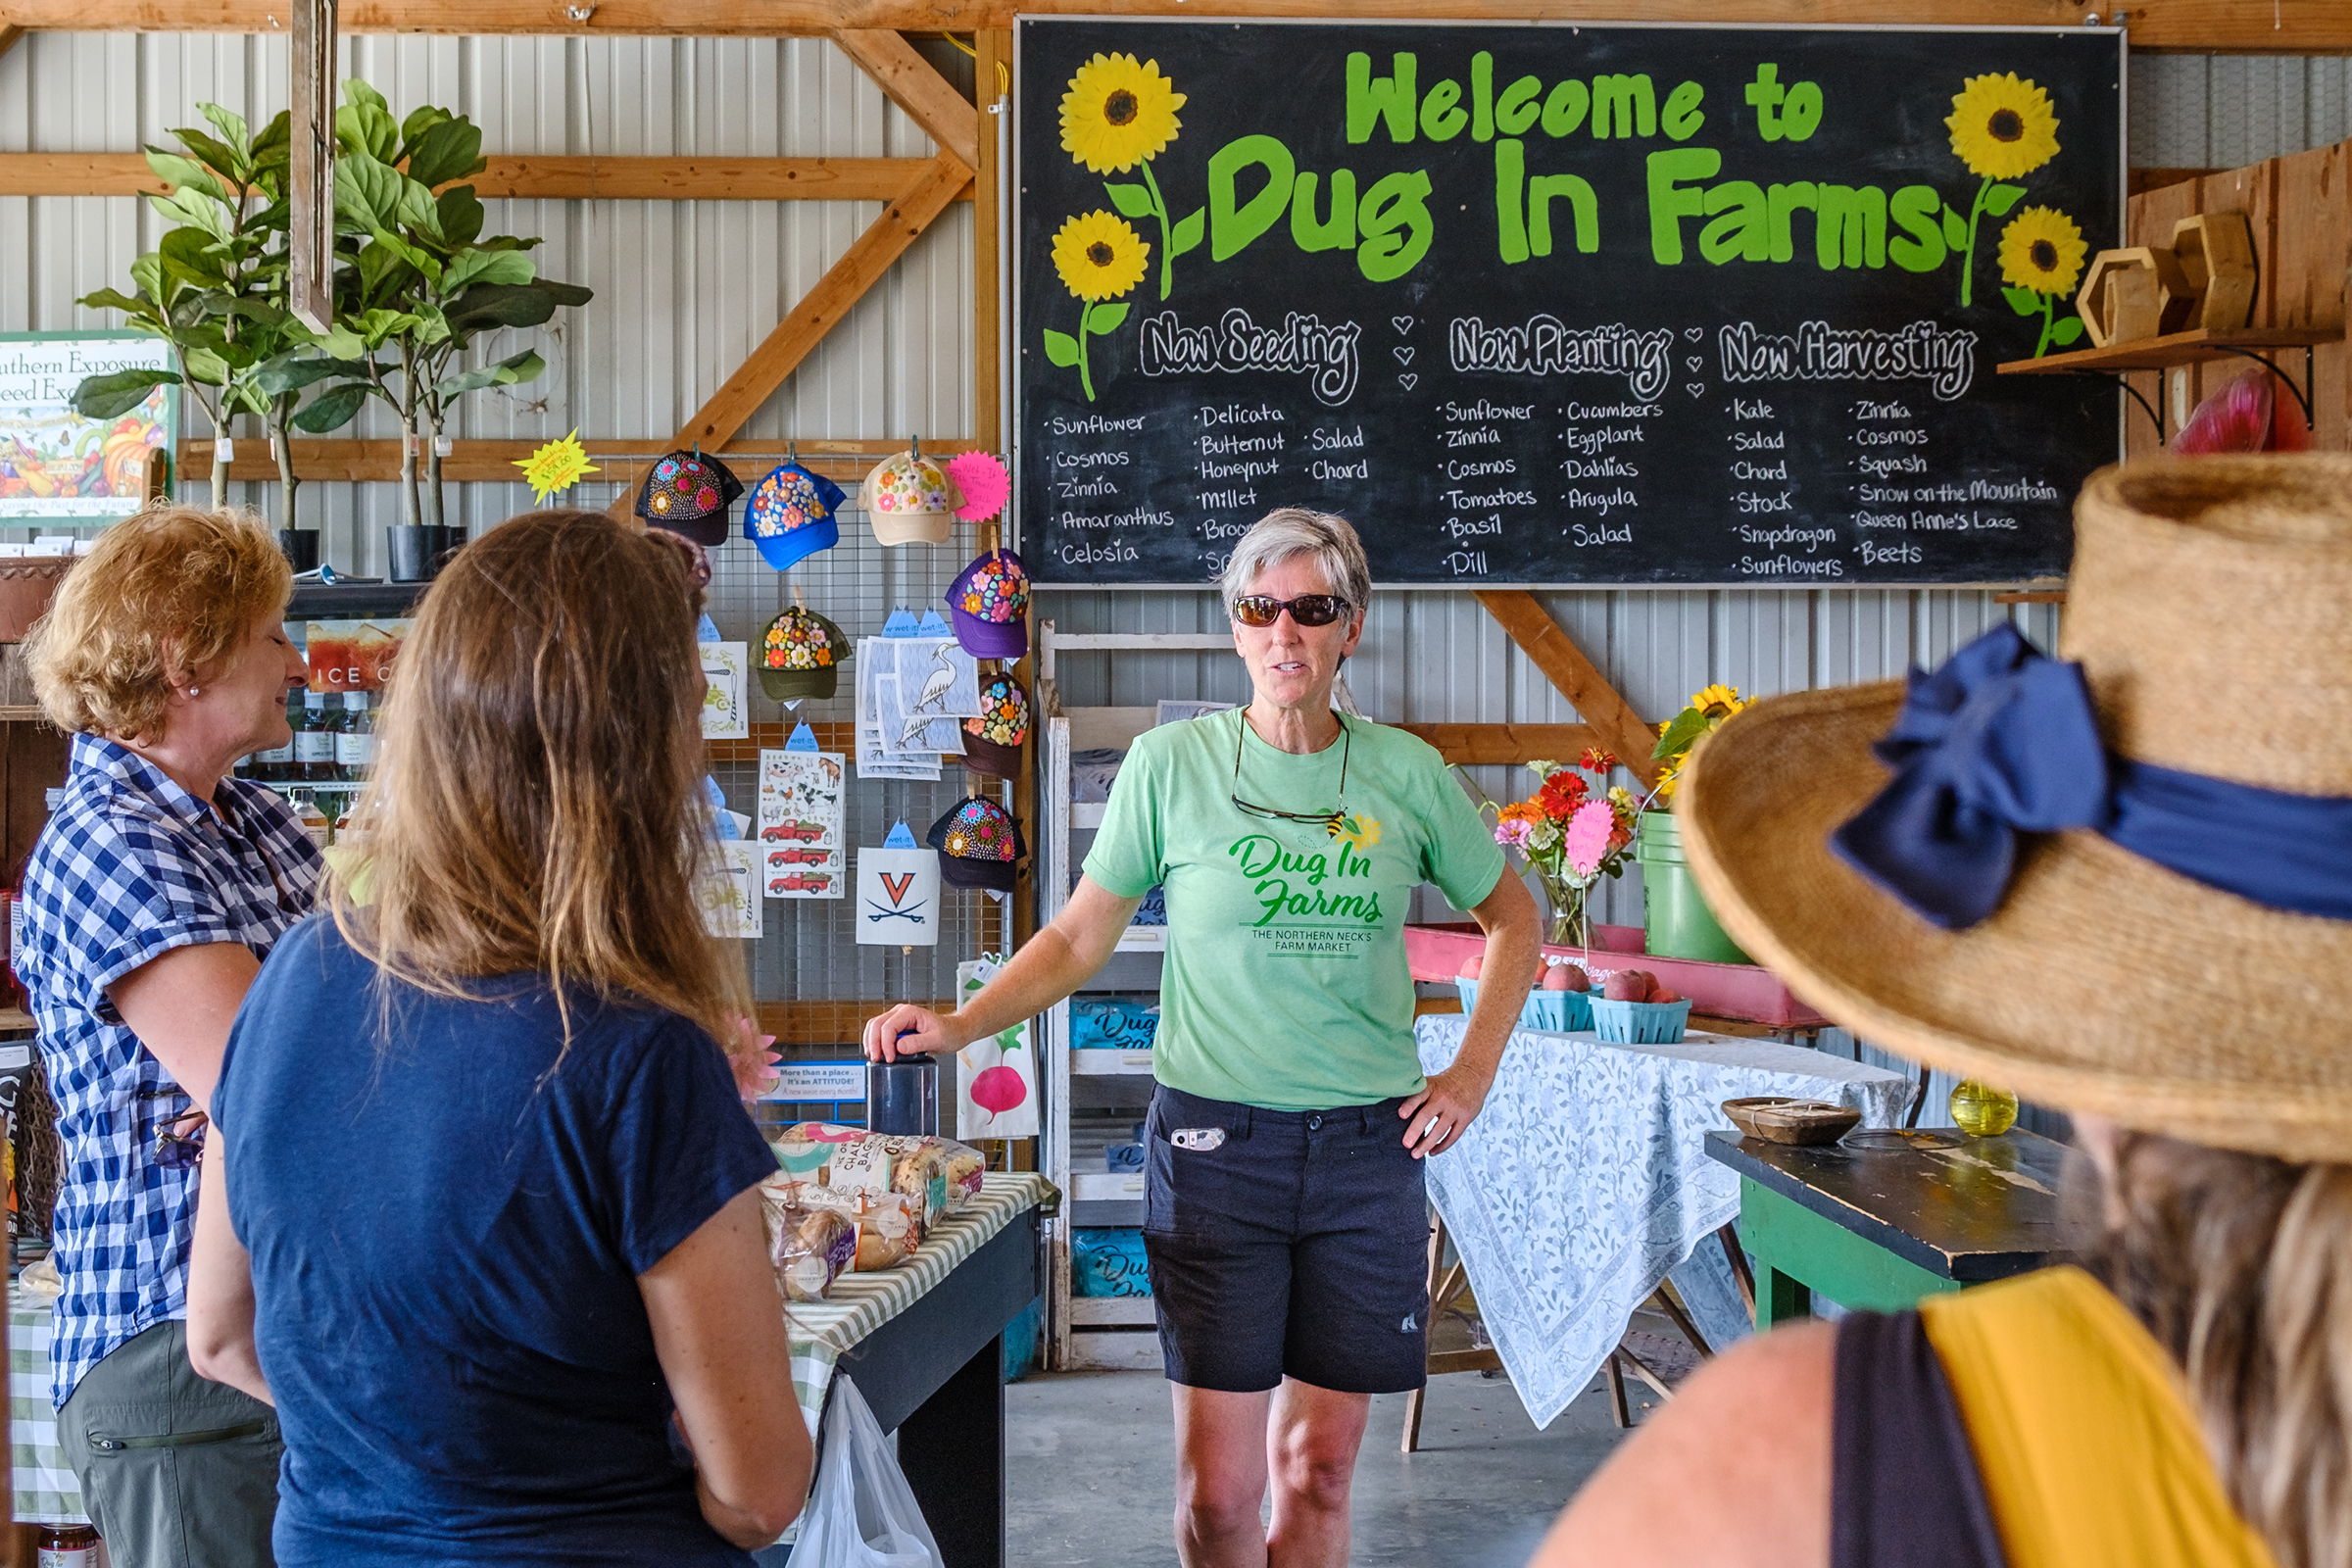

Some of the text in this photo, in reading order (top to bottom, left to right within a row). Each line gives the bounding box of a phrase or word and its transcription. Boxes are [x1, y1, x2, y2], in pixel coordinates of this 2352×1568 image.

[1346, 51, 1824, 144] Welcome to
[1207, 133, 1948, 283] Dug In Farms
[1148, 313, 1356, 401] Now Seeding
[1454, 318, 1669, 398] Now Planting
[1723, 325, 1973, 397] Now Harvesting
[1200, 403, 1285, 427] Delicata
[1446, 398, 1536, 421] Sunflower
[1568, 401, 1664, 420] Cucumbers
[1733, 397, 1775, 421] Kale
[1856, 400, 1911, 420] Zinnia
[1053, 415, 1147, 435] Sunflower
[1311, 424, 1364, 451] Salad
[1446, 425, 1501, 448] Zinnia
[1856, 428, 1929, 446] Cosmos
[1200, 431, 1285, 456] Butternut
[1568, 424, 1645, 456] Eggplant
[1734, 430, 1785, 452] Salad
[1056, 451, 1130, 468] Cosmos
[1200, 457, 1280, 483] Honeynut
[1312, 459, 1369, 480] Chard
[1447, 459, 1517, 480] Cosmos
[1564, 455, 1640, 479] Dahlias
[1859, 454, 1928, 479] Squash
[1056, 474, 1119, 499] Zinnia
[1446, 487, 1538, 510] Tomatoes
[1860, 476, 2058, 502] Snow on the Mountain
[1568, 486, 1639, 516] Arugula
[1737, 490, 1793, 514] Stock
[1061, 506, 1175, 529] Amaranthus
[1446, 513, 1502, 539] Basil
[1856, 510, 2019, 530] Queen Anne's Lace
[1572, 522, 1633, 547] Salad
[1740, 523, 1837, 554] Snapdragon
[1061, 538, 1140, 564] Celosia
[1446, 550, 1489, 576] Dill
[1861, 540, 1923, 566] Beets
[1740, 553, 1843, 577] Sunflowers
[318, 667, 361, 684] ICE
[1228, 834, 1372, 886] Dug In
[1252, 878, 1384, 928] Farms
[1251, 929, 1373, 943] THE NORTHERN NECK'S
[1275, 941, 1352, 953] FARM MARKET
[1094, 1009, 1157, 1038] Dug
[844, 1142, 861, 1171] CHAL
[858, 1144, 872, 1166] BAG
[1094, 1253, 1149, 1283] Du
